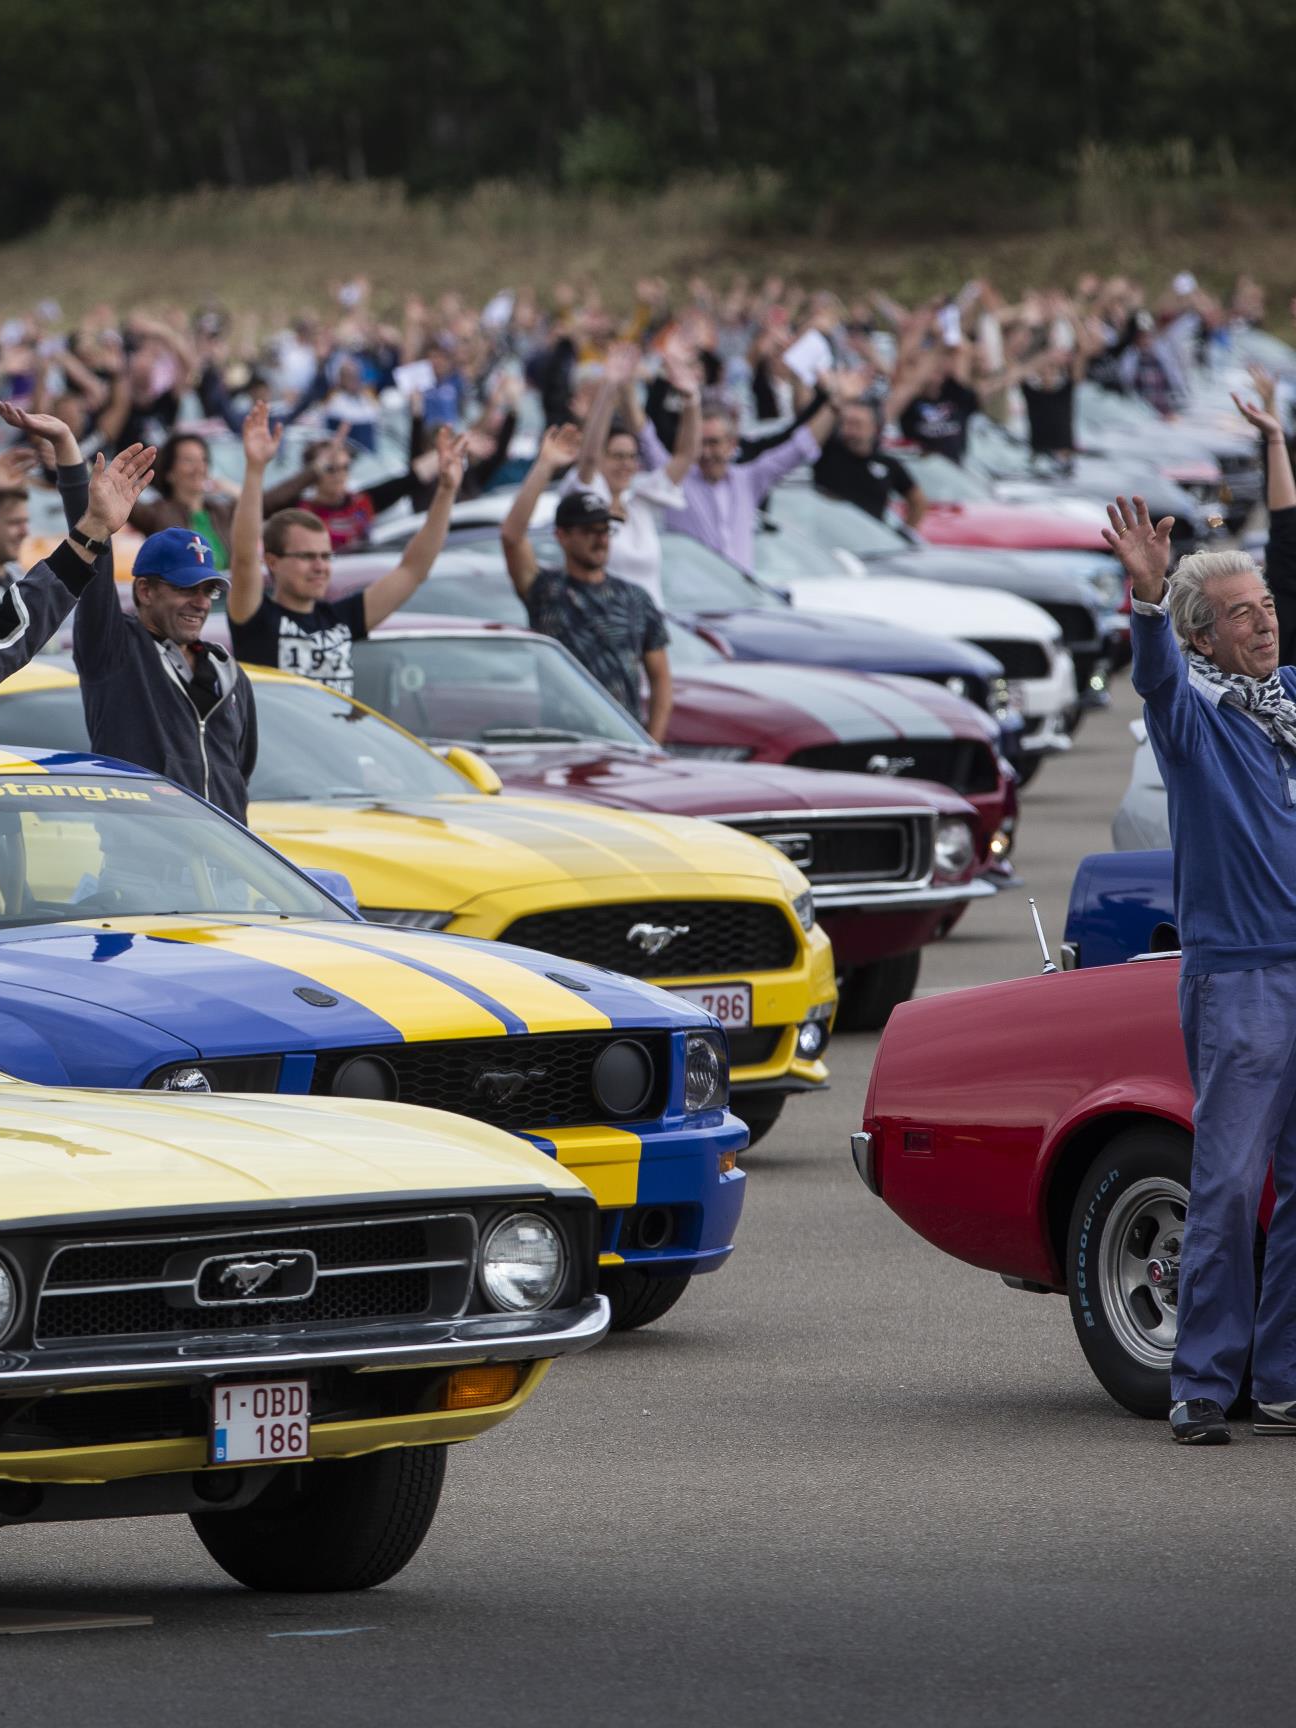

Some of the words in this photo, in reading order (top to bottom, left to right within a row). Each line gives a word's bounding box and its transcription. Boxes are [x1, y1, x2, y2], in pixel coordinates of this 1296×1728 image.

[703, 994, 743, 1020] 786
[1078, 1169, 1120, 1327] BFGoodrich
[217, 1448, 224, 1458] B
[256, 1423, 301, 1454] 186
